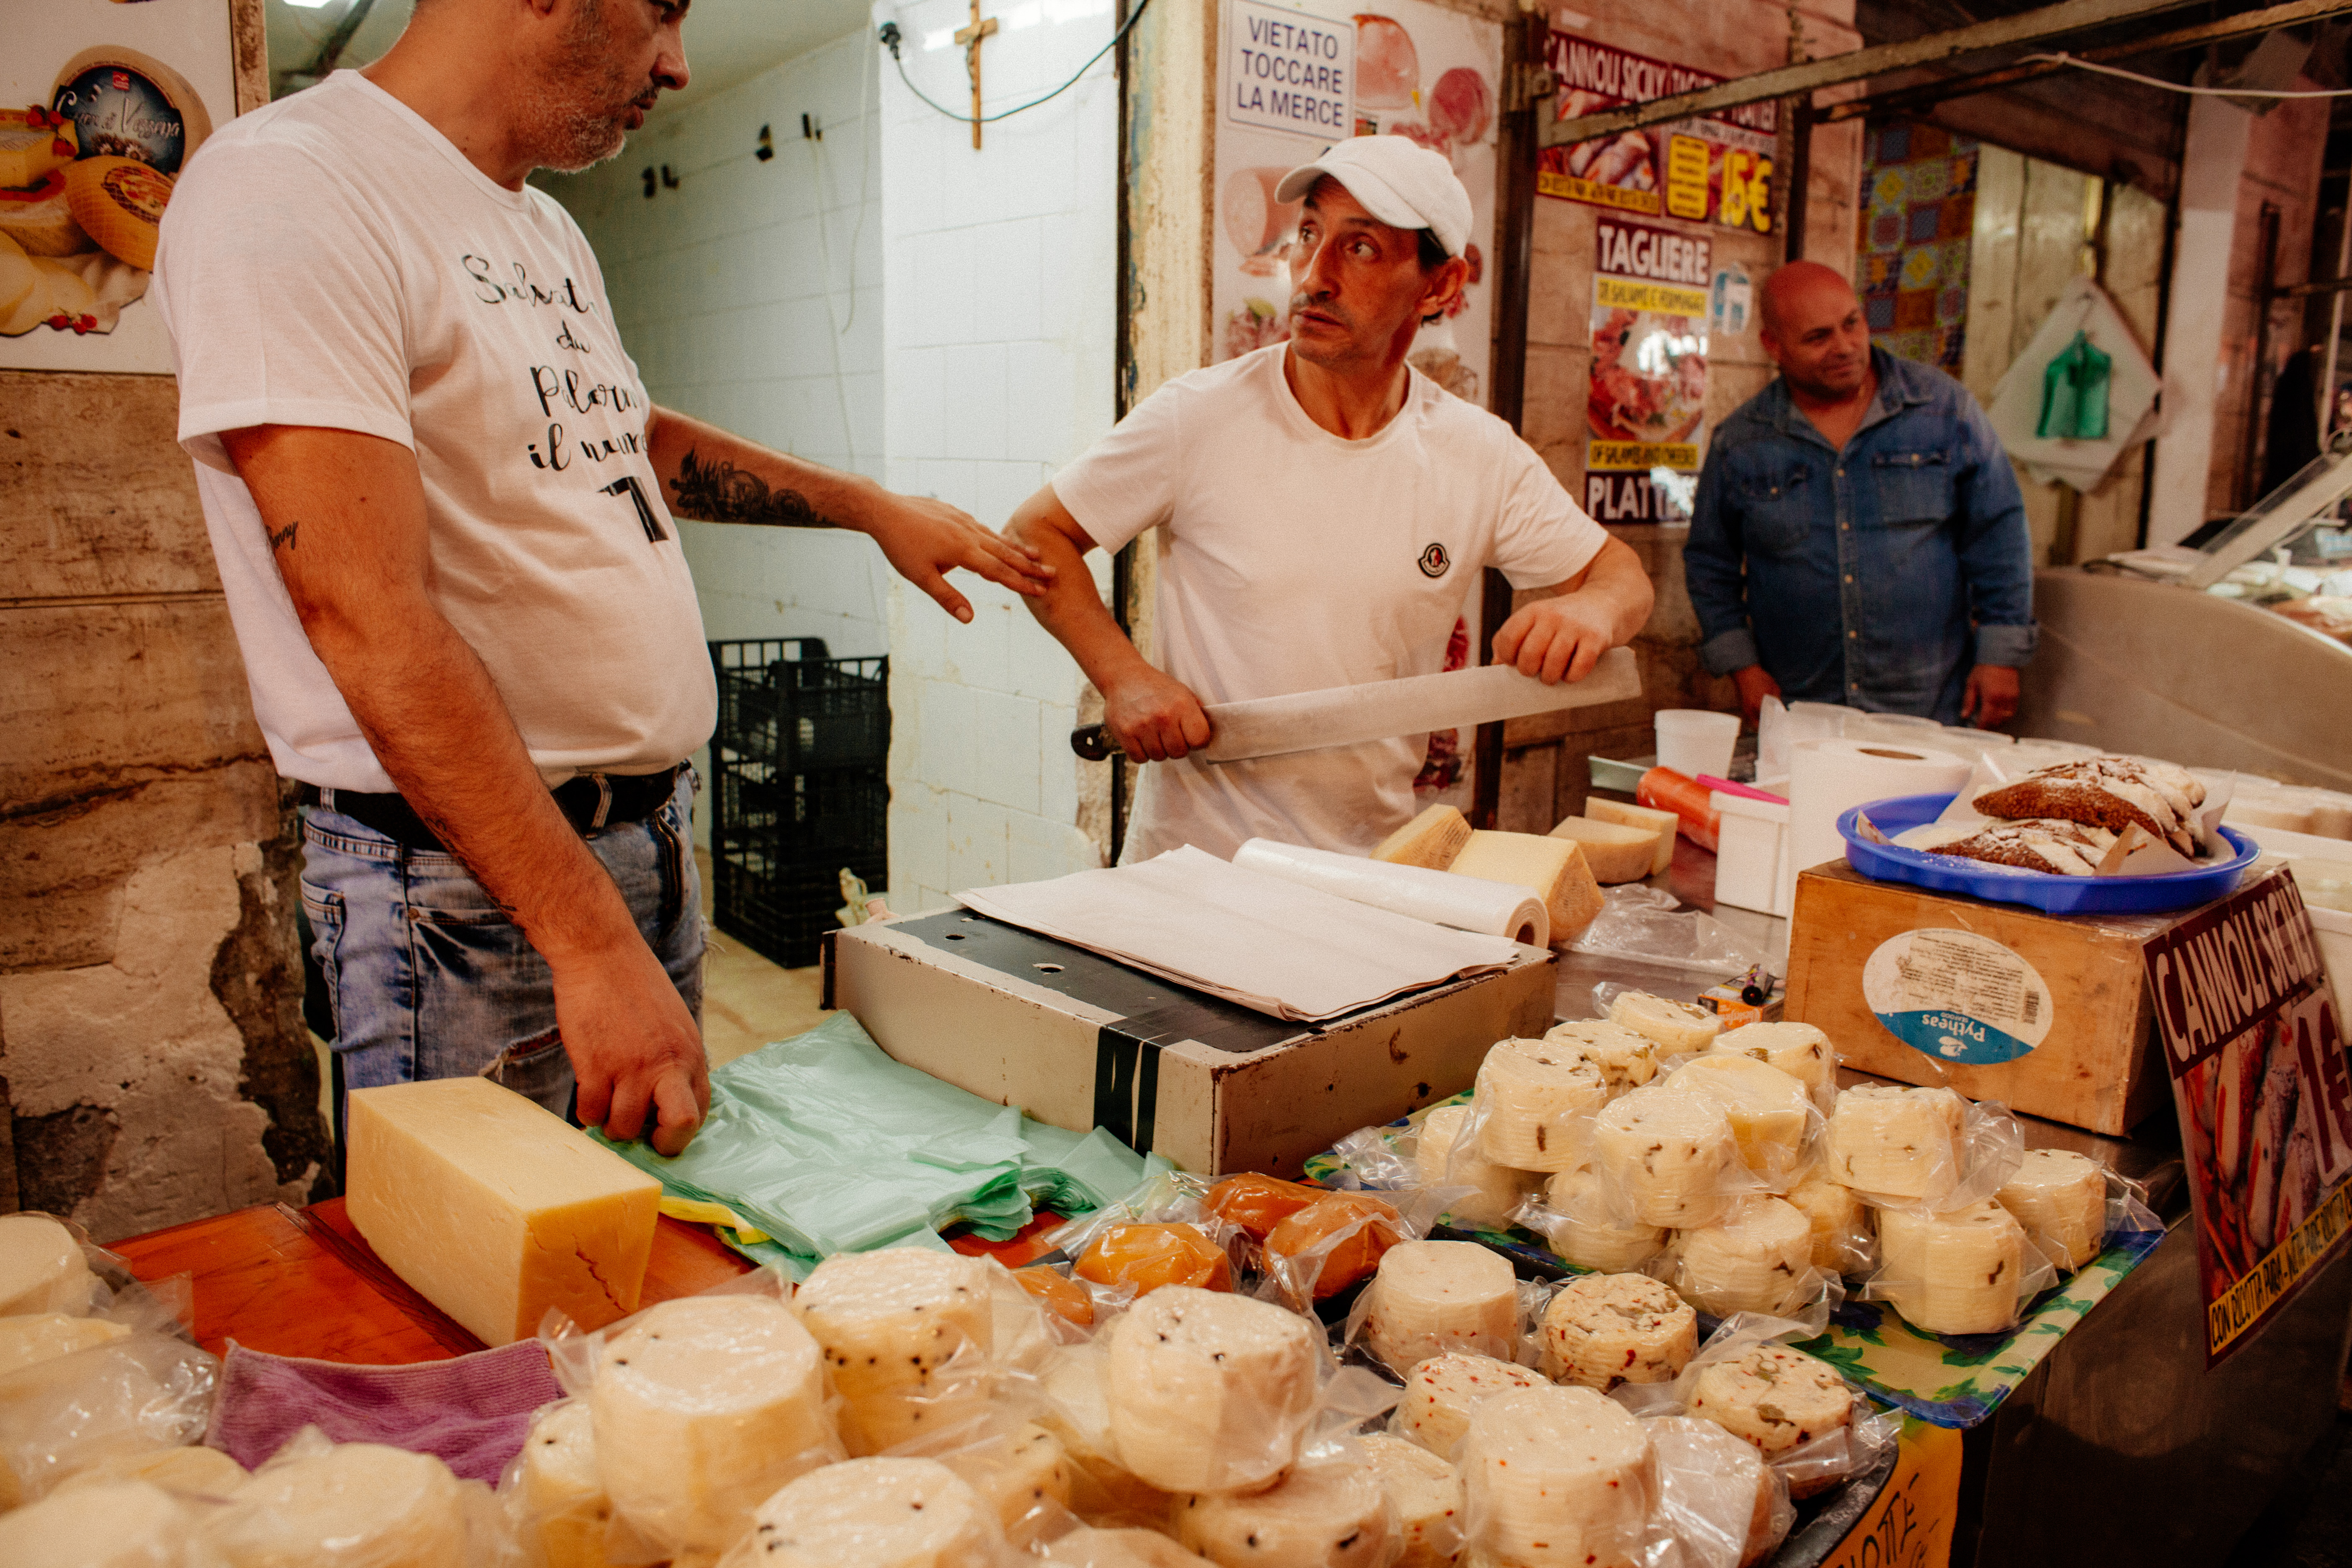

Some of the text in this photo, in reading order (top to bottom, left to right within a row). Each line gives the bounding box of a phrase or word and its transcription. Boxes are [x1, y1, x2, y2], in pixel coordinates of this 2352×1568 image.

[1248, 15, 1338, 59] VIETATO
[1241, 48, 1343, 94] TOCCARE
[1238, 82, 1343, 127] LA MERCE
[1599, 224, 1710, 286] TAGLIERE
[528, 423, 571, 472] il
[2156, 910, 2271, 1063] CANNOLI
[2252, 881, 2318, 998] SICILY
[1921, 1014, 1986, 1042] Pytheas
[2212, 1302, 2231, 1348] CON
[2231, 1270, 2263, 1334] RICOTTA
